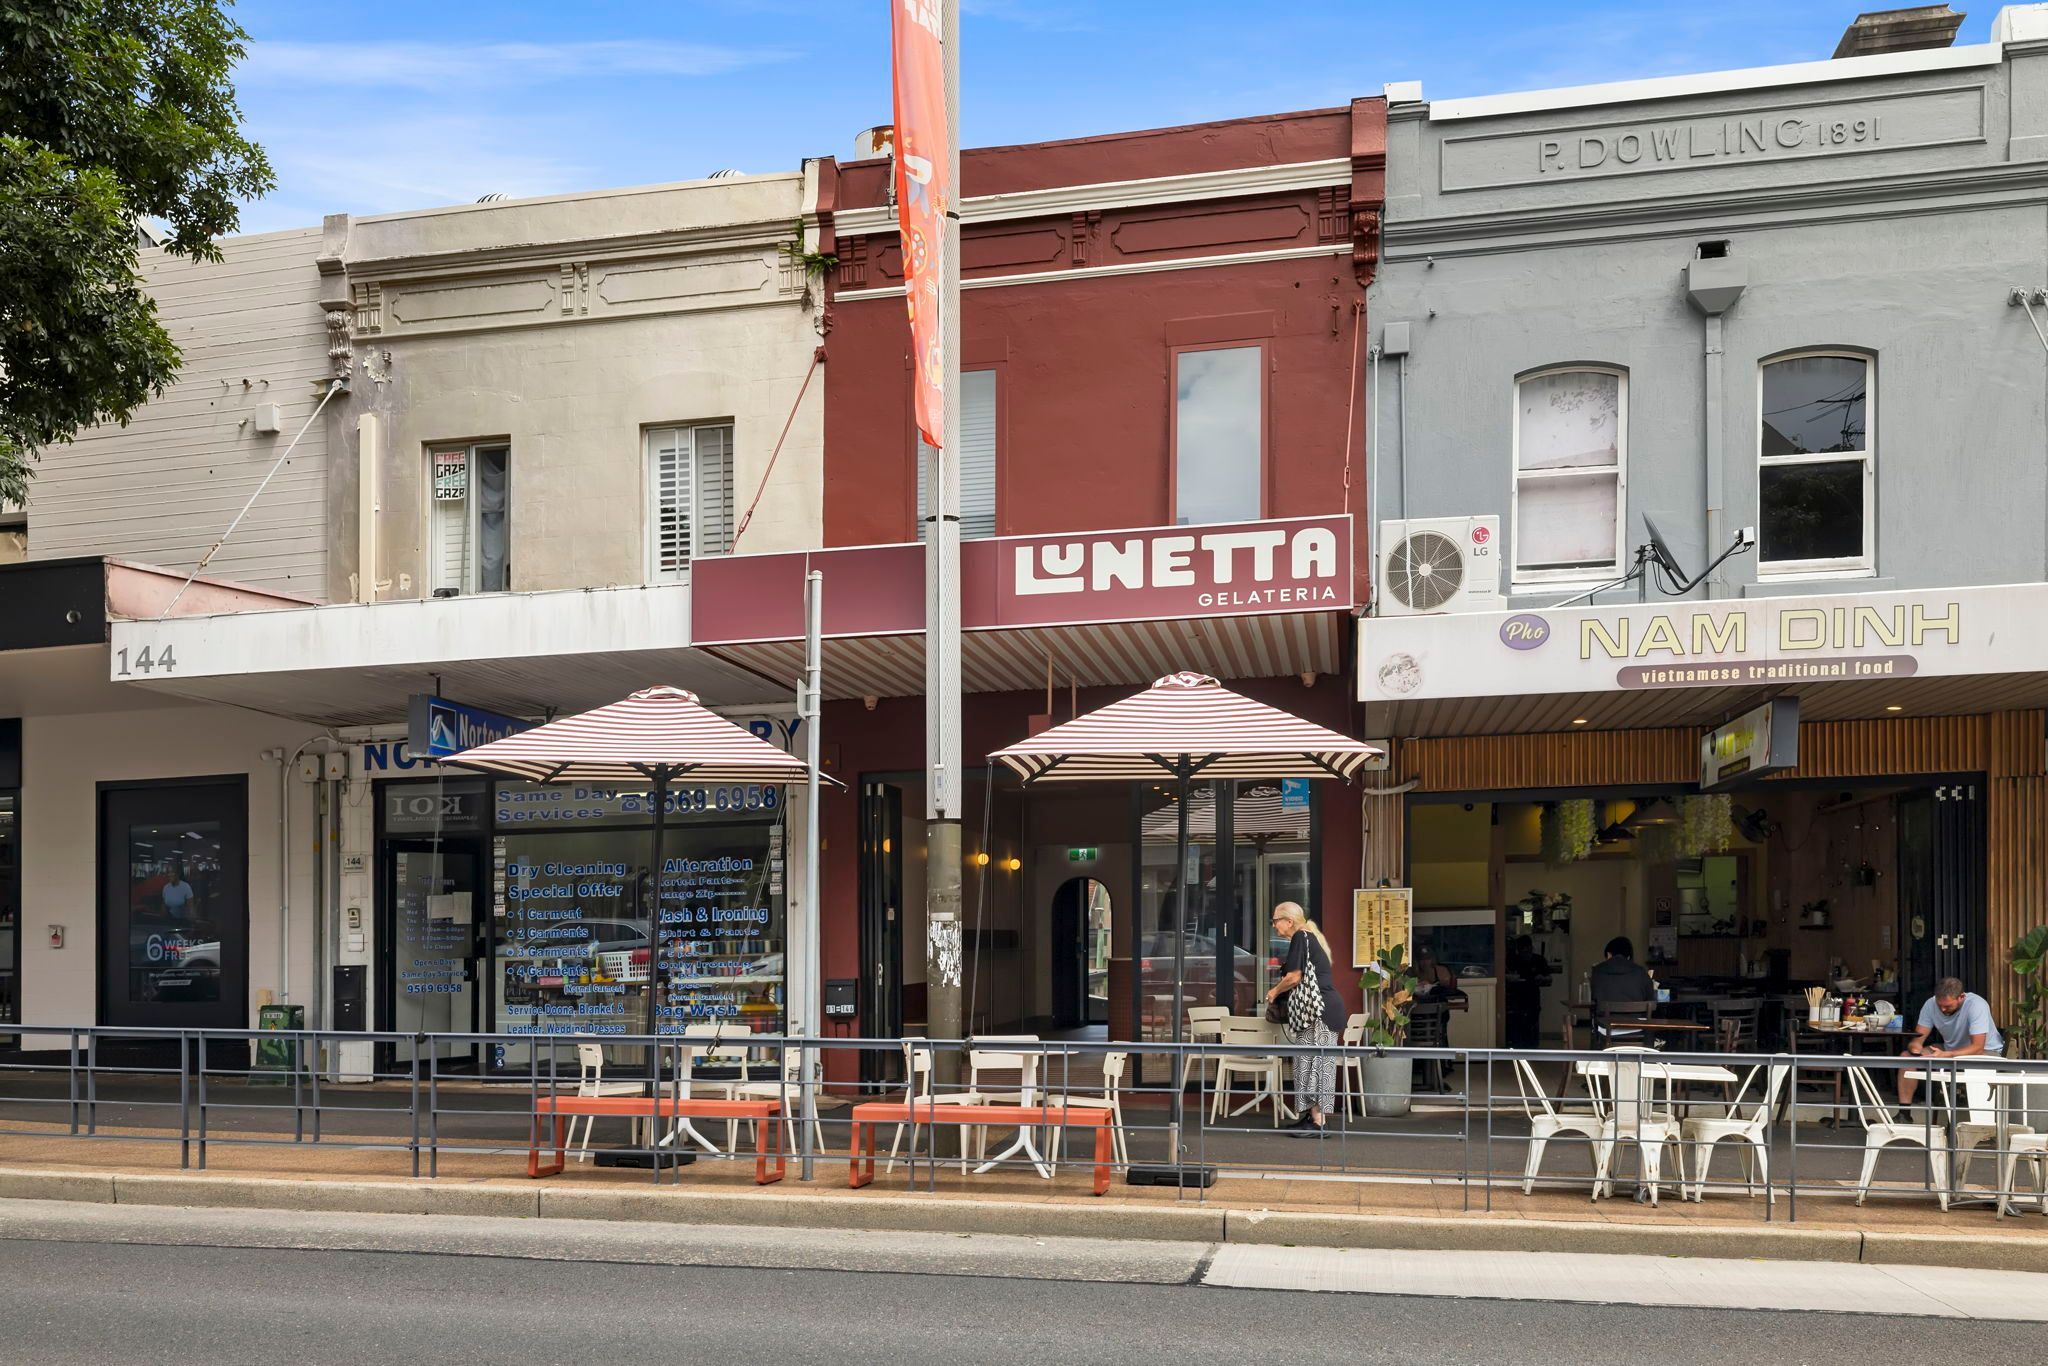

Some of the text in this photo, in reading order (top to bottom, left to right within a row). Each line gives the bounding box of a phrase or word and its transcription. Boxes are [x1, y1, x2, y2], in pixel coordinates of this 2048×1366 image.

[1817, 116, 1883, 146] 1891
[435, 451, 466, 464] FREE
[435, 463, 466, 479] GAZA
[435, 472, 466, 488] FREE
[435, 487, 466, 499] GAZA
[1473, 546, 1489, 557] LG
[1014, 526, 1337, 597] LUNETTA
[1197, 585, 1337, 607] GELATERIA
[1504, 620, 1545, 641] Pho
[1579, 602, 1961, 660] NAM DINH
[117, 644, 177, 676] 144
[1641, 659, 1894, 684] vietnamese traditional food
[497, 787, 619, 803] Same Day
[714, 783, 778, 812] 6958
[497, 807, 604, 822] Services
[346, 857, 361, 866] 144
[507, 860, 626, 879] Dry Cleaning
[663, 856, 754, 873] Alteration
[508, 882, 624, 901] Special Offer
[517, 906, 583, 920] 1 Garment
[695, 906, 709, 923] &
[711, 905, 769, 923] Ironing
[516, 926, 589, 940] 2 Garments
[516, 946, 589, 958] 3 Garments
[401, 971, 421, 979] Same
[516, 964, 589, 978] 4 Garments
[406, 983, 463, 994] 9569 6958
[507, 1004, 544, 1017] Service
[578, 1002, 616, 1016] Blanket
[689, 1003, 738, 1017] Wash
[587, 1022, 627, 1035] Dresses
